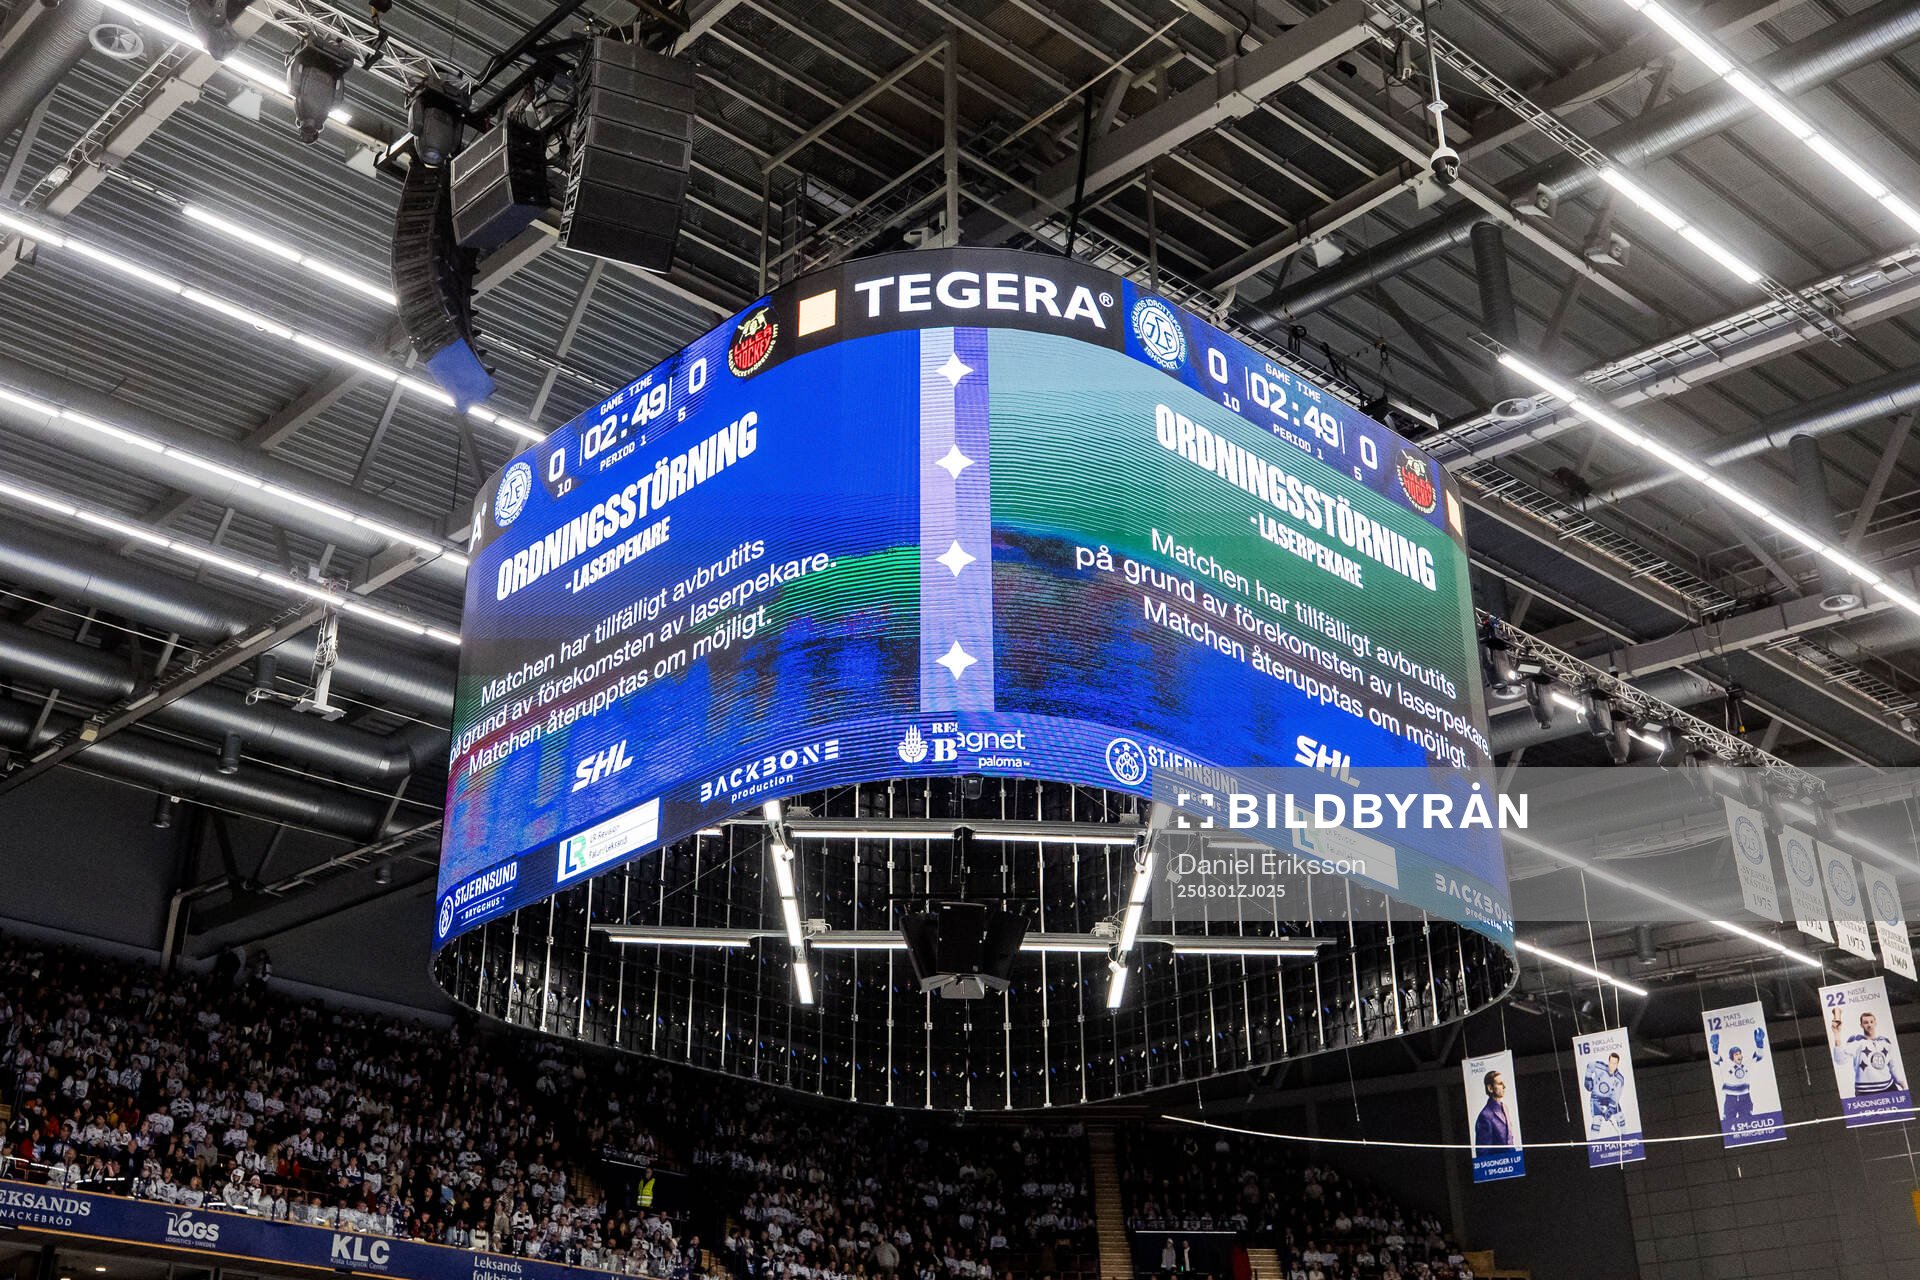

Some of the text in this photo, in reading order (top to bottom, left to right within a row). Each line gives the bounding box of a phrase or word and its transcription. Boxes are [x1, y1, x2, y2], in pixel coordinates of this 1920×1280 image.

[688, 357, 707, 395] 0
[1208, 347, 1228, 385] 0
[1265, 362, 1321, 404] GAME TIME
[600, 374, 653, 416] GAME TIME
[1223, 391, 1241, 414] 10
[1251, 371, 1339, 449] 02:49
[583, 382, 666, 461] 02:49
[677, 406, 687, 423] 5
[599, 434, 647, 472] PERIOD 1
[1273, 423, 1325, 462] PERIOD 1
[1359, 435, 1378, 470] 0
[548, 446, 566, 483] 0
[1353, 465, 1363, 482] 5
[496, 410, 758, 601] ORDNINGSSTÖRNING
[557, 477, 572, 498] 10
[1155, 403, 1437, 591] ORDNINGSSTÖRNING
[480, 537, 766, 708] Matchen har tillfälligt avbrutits
[1150, 528, 1457, 700] Matchen har tillfälligt avbrutits
[462, 703, 508, 755] grund
[511, 695, 534, 721] av
[537, 634, 655, 707] förekomsten
[660, 614, 685, 644] av
[689, 550, 838, 628] laserpekare.
[1075, 544, 1492, 761] på grund av förekomsten av laserpekare.
[468, 603, 773, 777] Matchen återupptas om möjligt.
[1143, 596, 1471, 772] Matchen återupptas om möjligt.
[931, 721, 958, 733] RE
[571, 739, 635, 793] SHL
[700, 739, 840, 803] BACKBONE
[1148, 744, 1240, 796] STJERNSUND
[1294, 734, 1361, 789] SHL
[731, 773, 794, 804] production
[454, 861, 518, 908] STJERNSUND
[465, 896, 501, 920] BRYGGHUS
[1846, 933, 1866, 952] 1973
[1825, 991, 1847, 1008] 22
[1707, 1011, 1742, 1031] 12 MATS
[1577, 1042, 1591, 1056] 16
[1736, 1118, 1775, 1131] SM-GULD
[331, 1233, 390, 1265] KLC
[473, 1255, 522, 1274] Leksands
